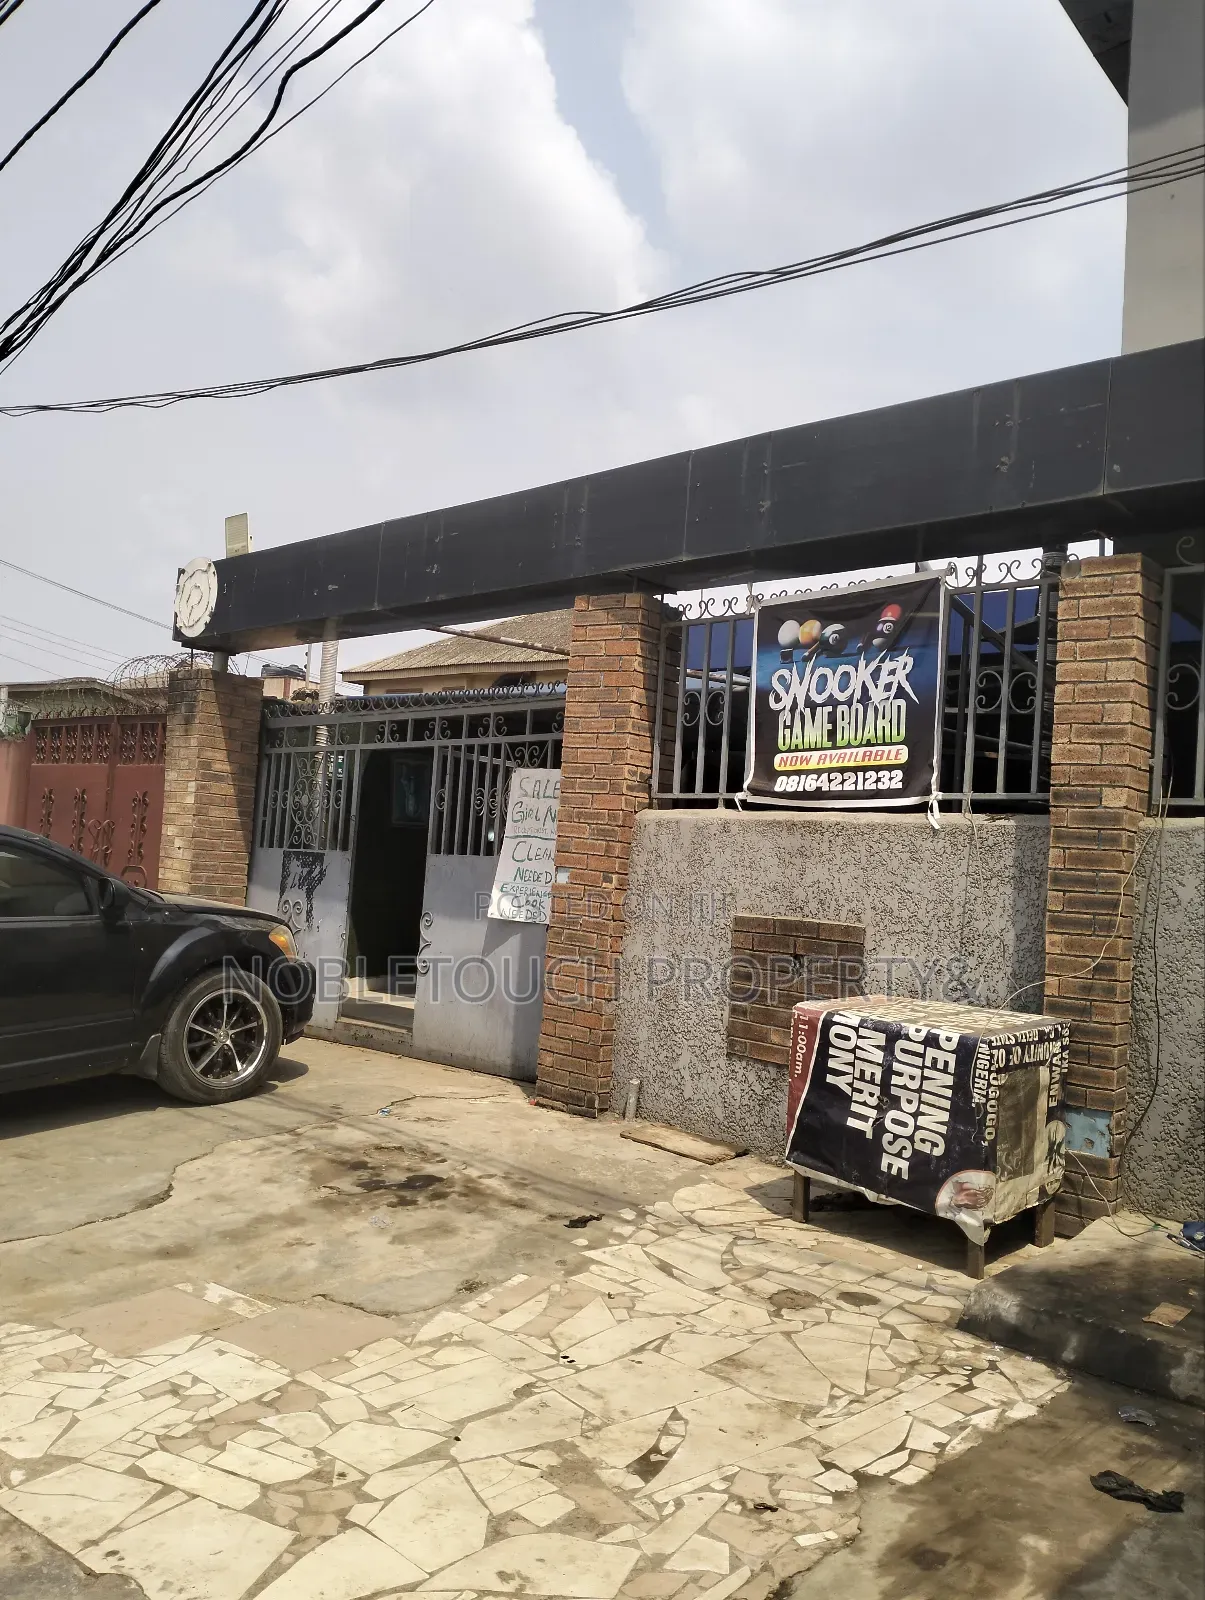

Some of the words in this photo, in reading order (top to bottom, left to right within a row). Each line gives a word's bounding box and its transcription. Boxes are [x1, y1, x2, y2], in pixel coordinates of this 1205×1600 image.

[769, 647, 919, 716] SNOOKER
[777, 705, 833, 752] GAME
[836, 698, 907, 748] BOARD
[773, 769, 903, 793] 08164221232
[777, 754, 813, 768] NOW
[817, 748, 904, 766] AVAILABLE
[846, 1026, 888, 1140] MERIT
[881, 1026, 932, 1181] PURPOSE
